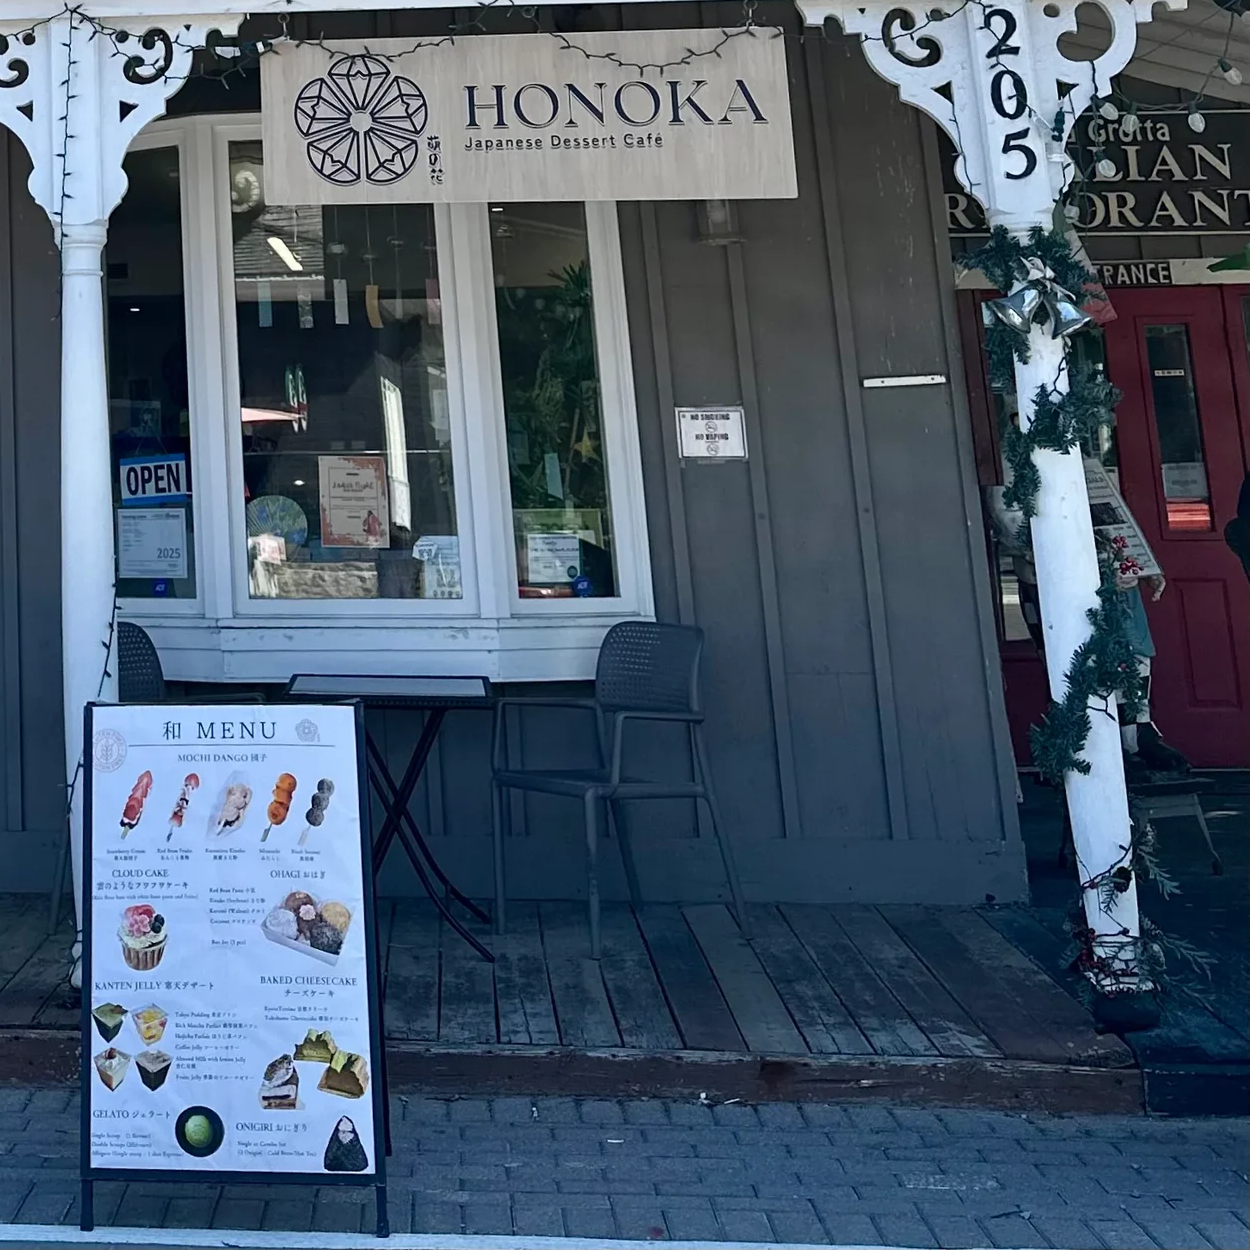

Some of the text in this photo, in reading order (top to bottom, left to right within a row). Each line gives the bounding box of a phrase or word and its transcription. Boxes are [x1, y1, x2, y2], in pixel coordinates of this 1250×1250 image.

[984, 8, 1038, 180] 205
[463, 79, 770, 130] HONOKA
[1088, 119, 1171, 142] Grotta
[464, 131, 664, 151] Japanese Dessert Café
[1094, 263, 1171, 285] RANCE
[700, 413, 730, 421] SMOKING
[705, 432, 729, 441] VAPING
[126, 462, 182, 496] OPEN
[156, 547, 181, 559] 2025
[162, 721, 277, 740] 和 MENU
[177, 754, 211, 762] MOCHI
[213, 754, 249, 762] DANGO
[111, 869, 170, 878] CLOUD CAKE
[270, 870, 326, 879] OHAGI おはぎ
[260, 975, 358, 986] BAKED CHEESECAKE
[95, 981, 132, 990] KANTEN
[134, 981, 161, 992] JELLY
[93, 1110, 129, 1119] GELATO
[236, 1122, 307, 1132] ONIGIRI おにぎり
